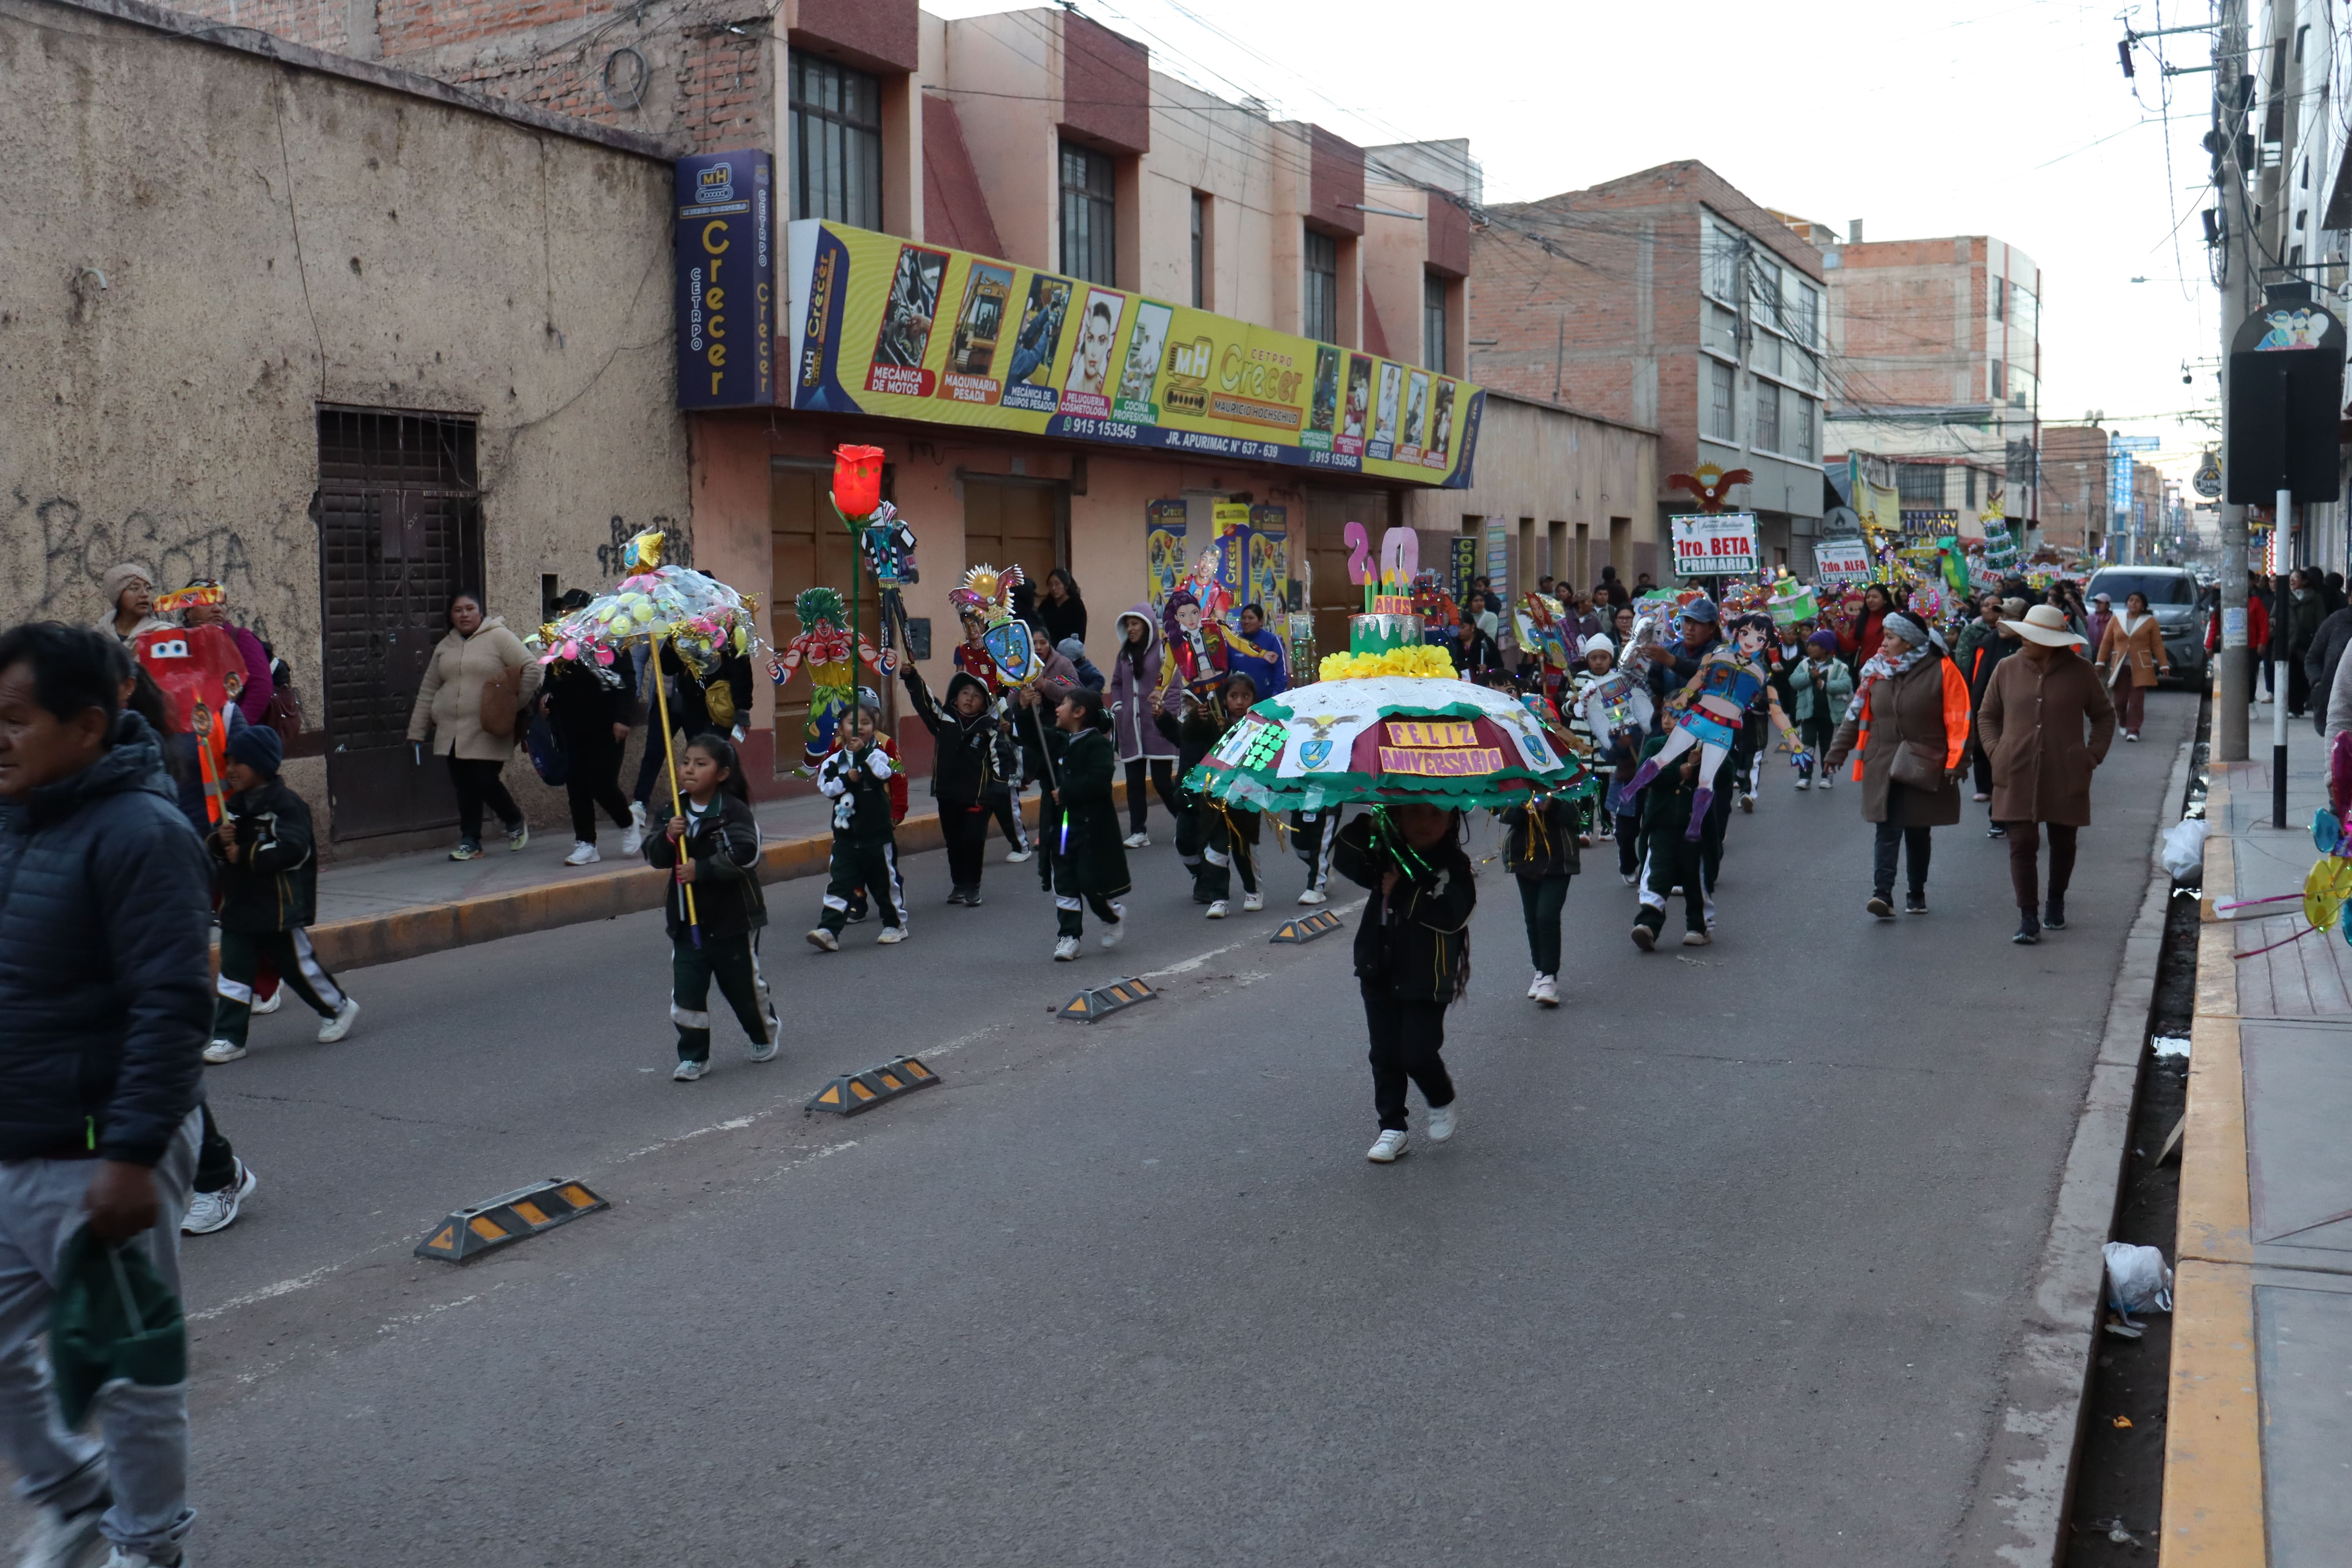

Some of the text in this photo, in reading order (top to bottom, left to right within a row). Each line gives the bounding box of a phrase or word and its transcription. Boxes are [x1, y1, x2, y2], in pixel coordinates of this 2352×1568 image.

[703, 169, 727, 185] MH
[808, 254, 829, 338] Crecer
[691, 268, 702, 350] CETRPO
[702, 220, 730, 395] Crecer
[757, 283, 768, 392] Crecer
[804, 350, 815, 379] MH
[1175, 344, 1210, 378] MH
[1251, 349, 1292, 367] CETPRO
[874, 365, 922, 383] MECÁNICA
[1220, 343, 1303, 403] Crecer
[871, 378, 919, 395] DE MOTOS
[944, 374, 997, 392] MAQUINARIA
[953, 387, 985, 402] PESADA
[1011, 385, 1051, 401] MECÁNICA DE
[1067, 393, 1105, 407] PELUQUERIA
[1003, 395, 1056, 411] EQUIPOS PESADOS
[1060, 401, 1108, 417] COSMETOLOGIA
[1124, 400, 1149, 413] COCINA
[1214, 399, 1298, 424] MAURICIO HOCHSCHILD
[1113, 409, 1156, 424] PROFESIONAL
[1073, 417, 1138, 439] 915 153545
[1165, 431, 1180, 445] JR.
[1182, 433, 1229, 452] APURIMAC
[1241, 441, 1258, 455] 637
[1263, 444, 1278, 458] 639
[1342, 445, 1355, 454] TEXTIL
[1370, 441, 1390, 451] ASISTENTE
[1315, 451, 1357, 467] 915 153545
[1368, 450, 1389, 459] CONTABLE
[1162, 505, 1183, 517] Crecer
[1907, 519, 1957, 535] LUXURY
[1344, 521, 1418, 588] 20
[1677, 537, 1750, 557] 1ro. BETA
[1226, 540, 1236, 584] Crecer
[1682, 557, 1751, 572] PRIMARIA
[1821, 559, 1867, 572] 2do. ALFA
[1375, 596, 1411, 613] AÑOS
[1390, 724, 1475, 744] FELIZ
[1381, 749, 1502, 774] ANIVERSARIO
